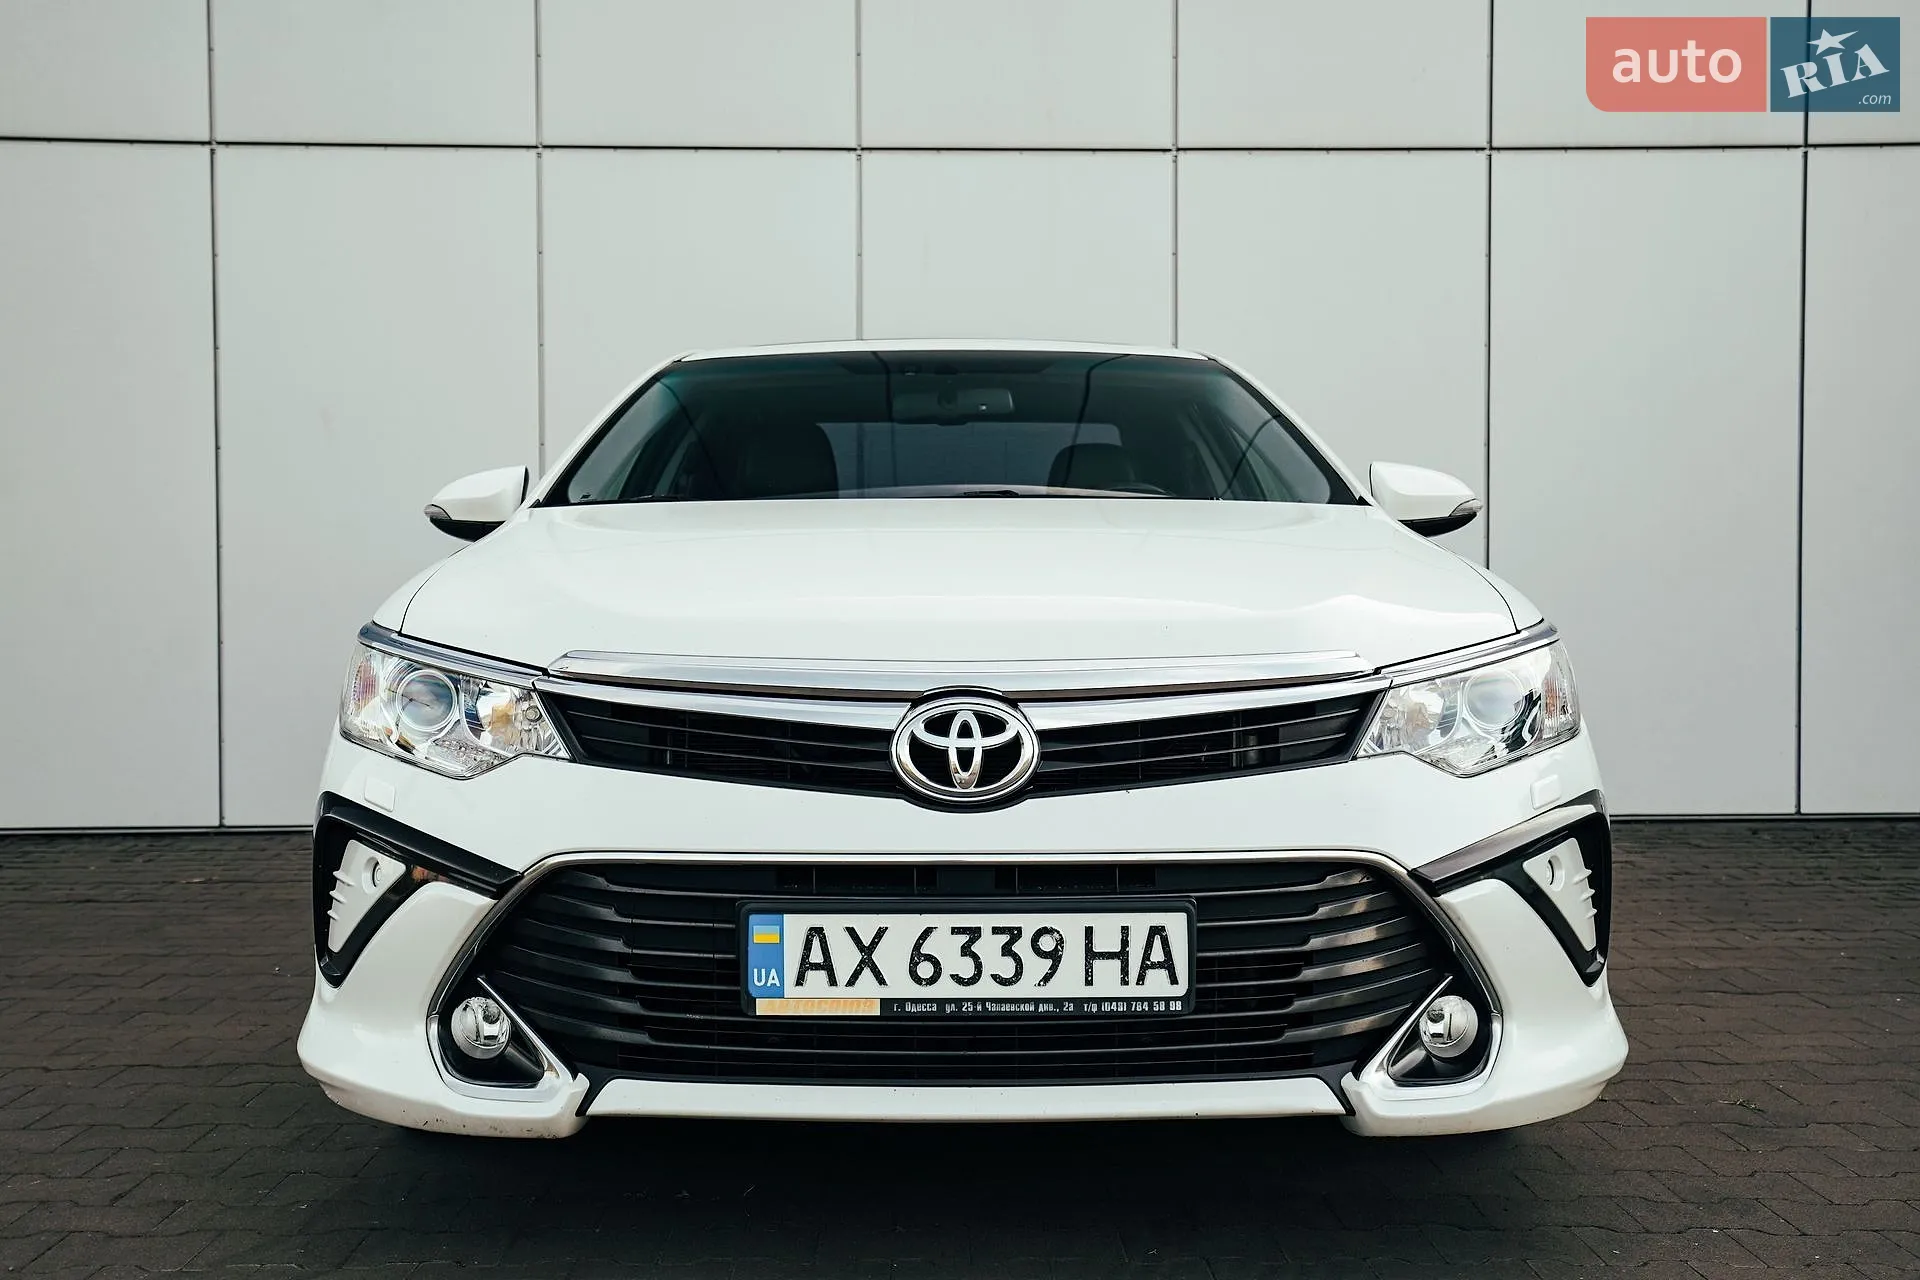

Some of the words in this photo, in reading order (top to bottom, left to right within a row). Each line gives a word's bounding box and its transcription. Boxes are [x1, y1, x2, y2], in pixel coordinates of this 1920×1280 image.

[795, 926, 889, 987] AX
[908, 926, 1065, 987] 6339
[1084, 925, 1179, 986] HA
[753, 968, 780, 987] UA
[893, 1003, 901, 1012] г.
[905, 1001, 937, 1013] Одесса
[945, 1003, 958, 1014] ул.
[985, 1001, 1035, 1012] Чапаевской
